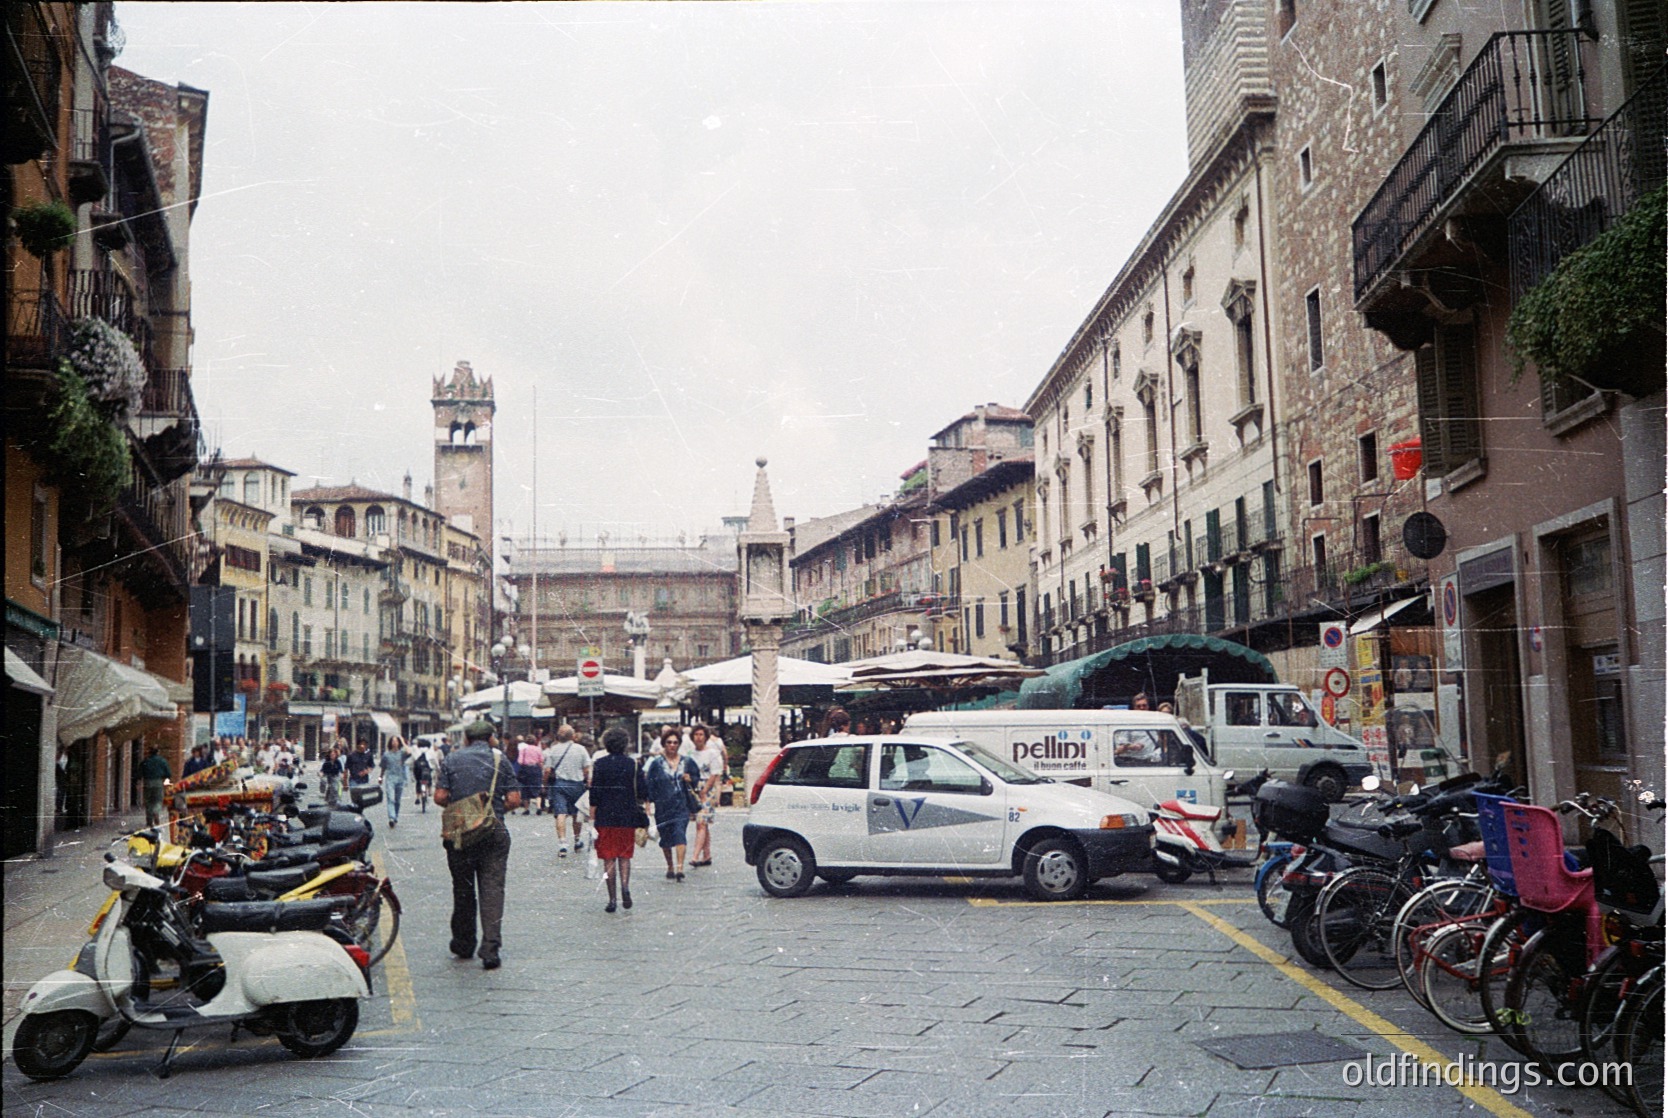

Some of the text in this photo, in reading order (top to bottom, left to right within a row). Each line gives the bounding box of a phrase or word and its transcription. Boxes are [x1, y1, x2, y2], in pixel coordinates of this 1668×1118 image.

[1012, 730, 1092, 763] pellini
[1033, 761, 1040, 771] il
[1041, 761, 1062, 771] buon
[1008, 811, 1021, 823] 82
